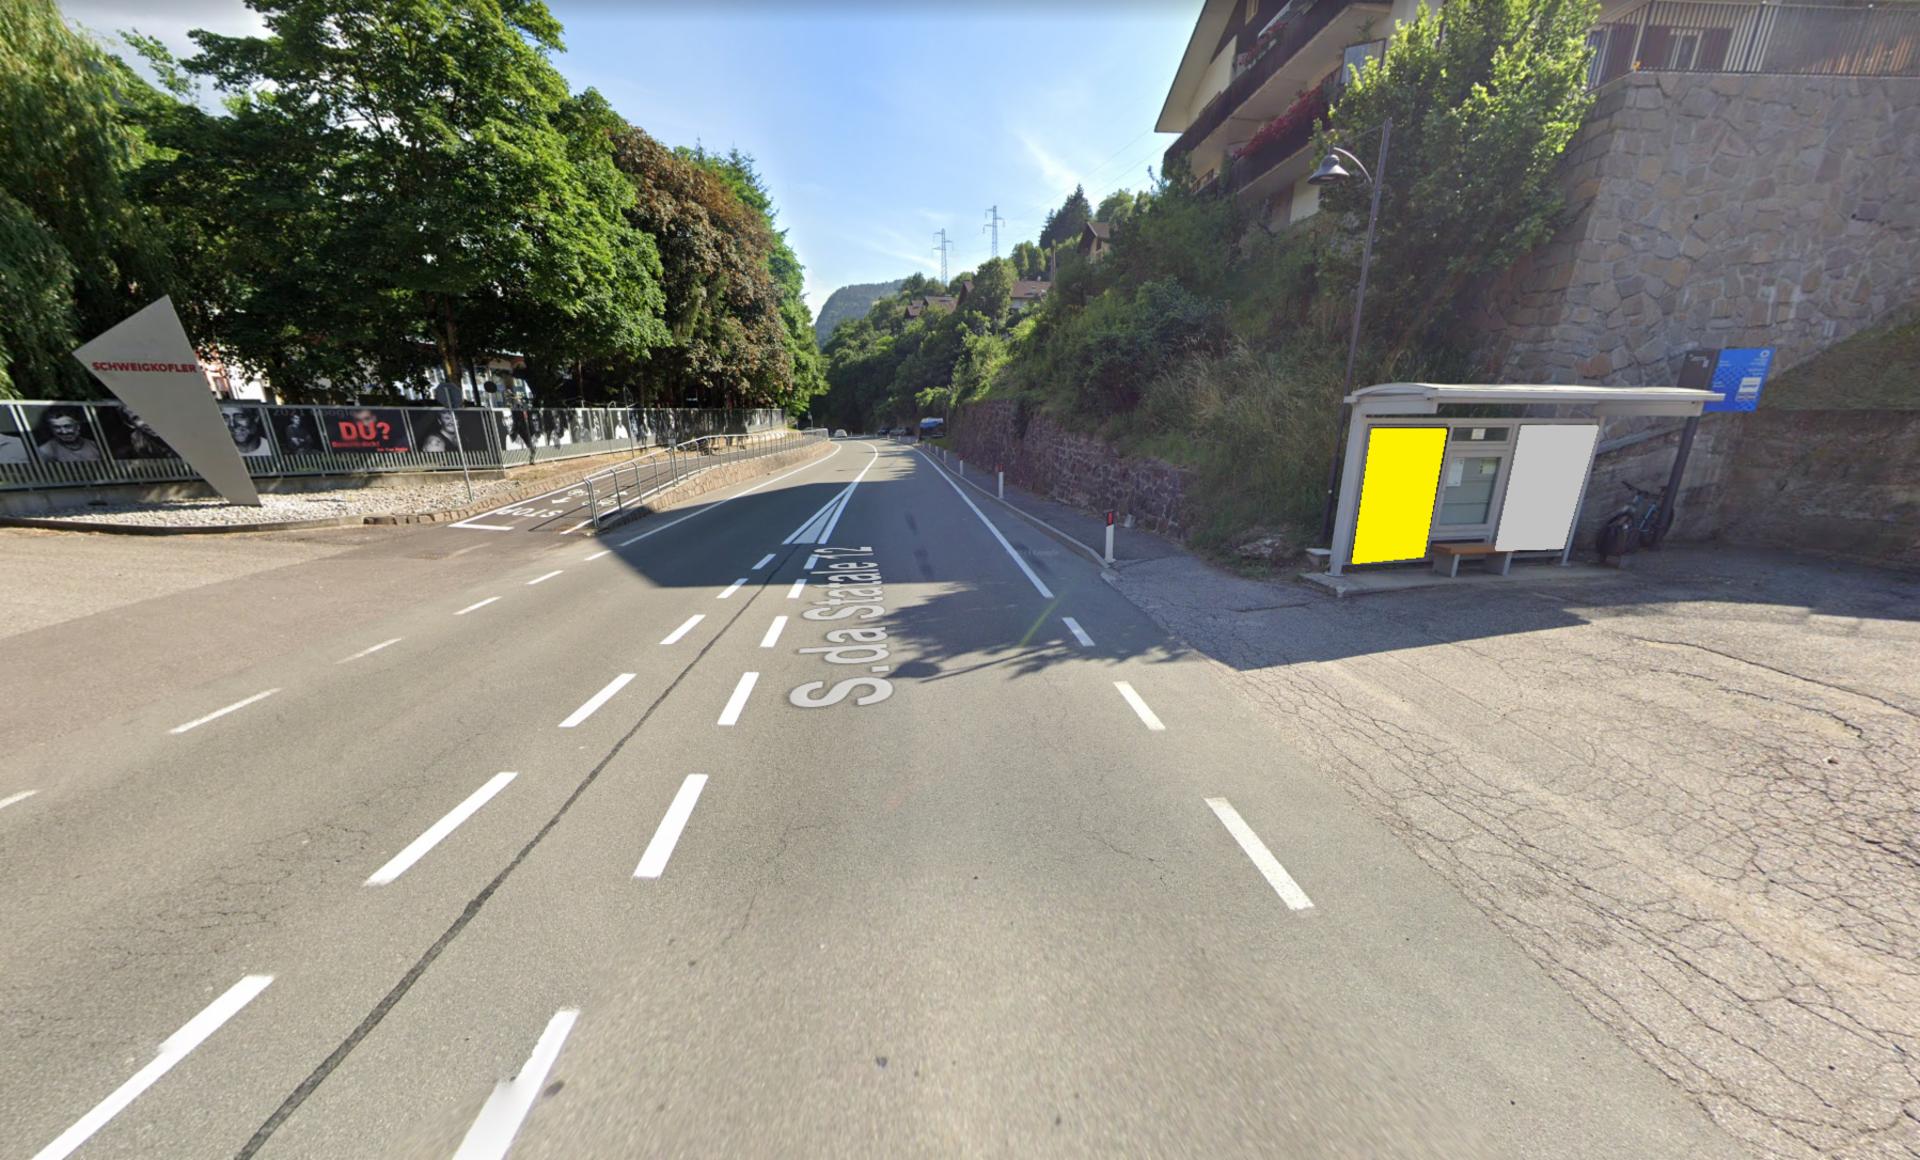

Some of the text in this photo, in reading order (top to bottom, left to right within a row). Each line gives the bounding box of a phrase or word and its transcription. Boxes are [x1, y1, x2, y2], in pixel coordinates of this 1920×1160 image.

[92, 362, 197, 373] SCHWEIGKOFLER
[338, 421, 391, 441] DU?
[496, 507, 563, 517] STOP
